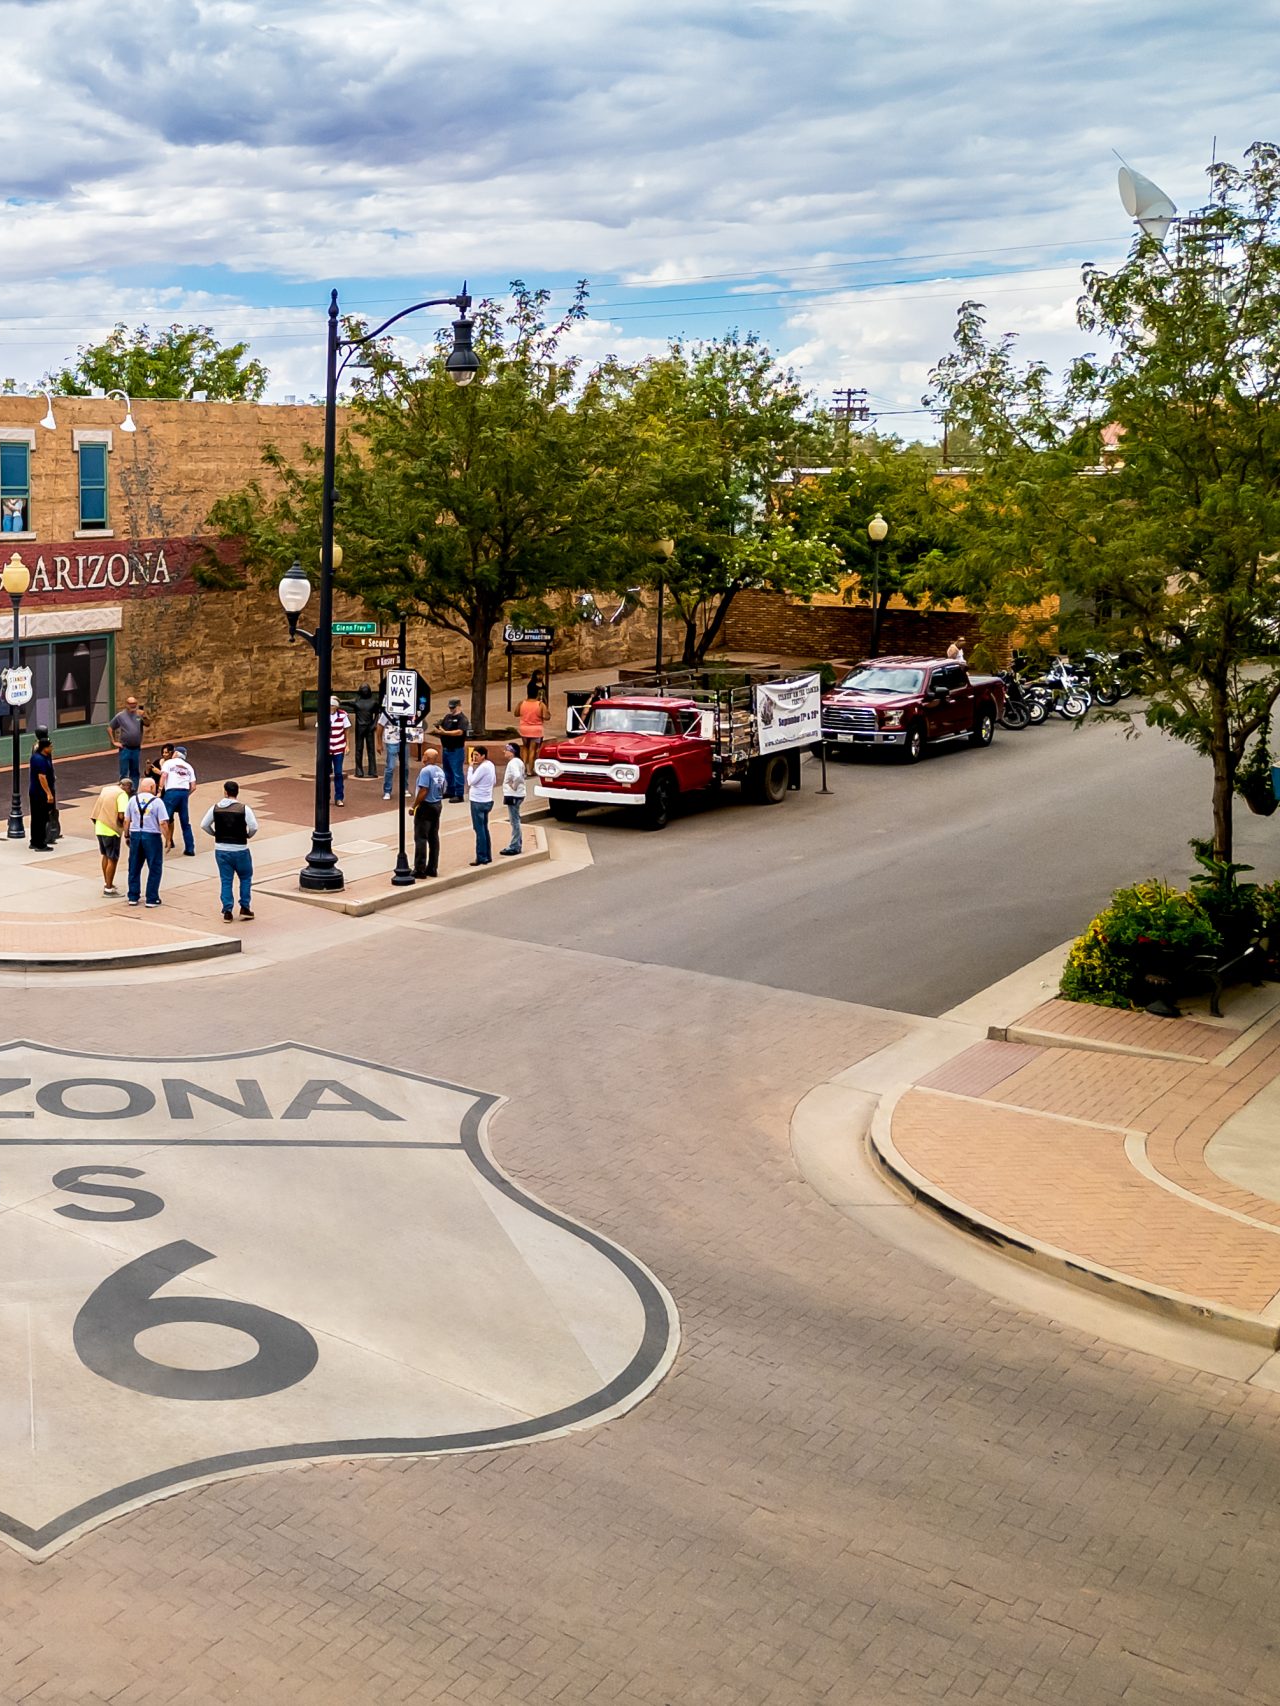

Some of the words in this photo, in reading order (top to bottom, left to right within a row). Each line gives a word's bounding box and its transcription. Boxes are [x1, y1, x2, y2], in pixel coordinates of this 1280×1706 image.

[29, 549, 173, 593] ARIZONA
[353, 624, 367, 632] Frey
[508, 630, 521, 640] 66
[368, 638, 390, 648] Second
[391, 674, 412, 686] ONE
[390, 686, 413, 698] WAY
